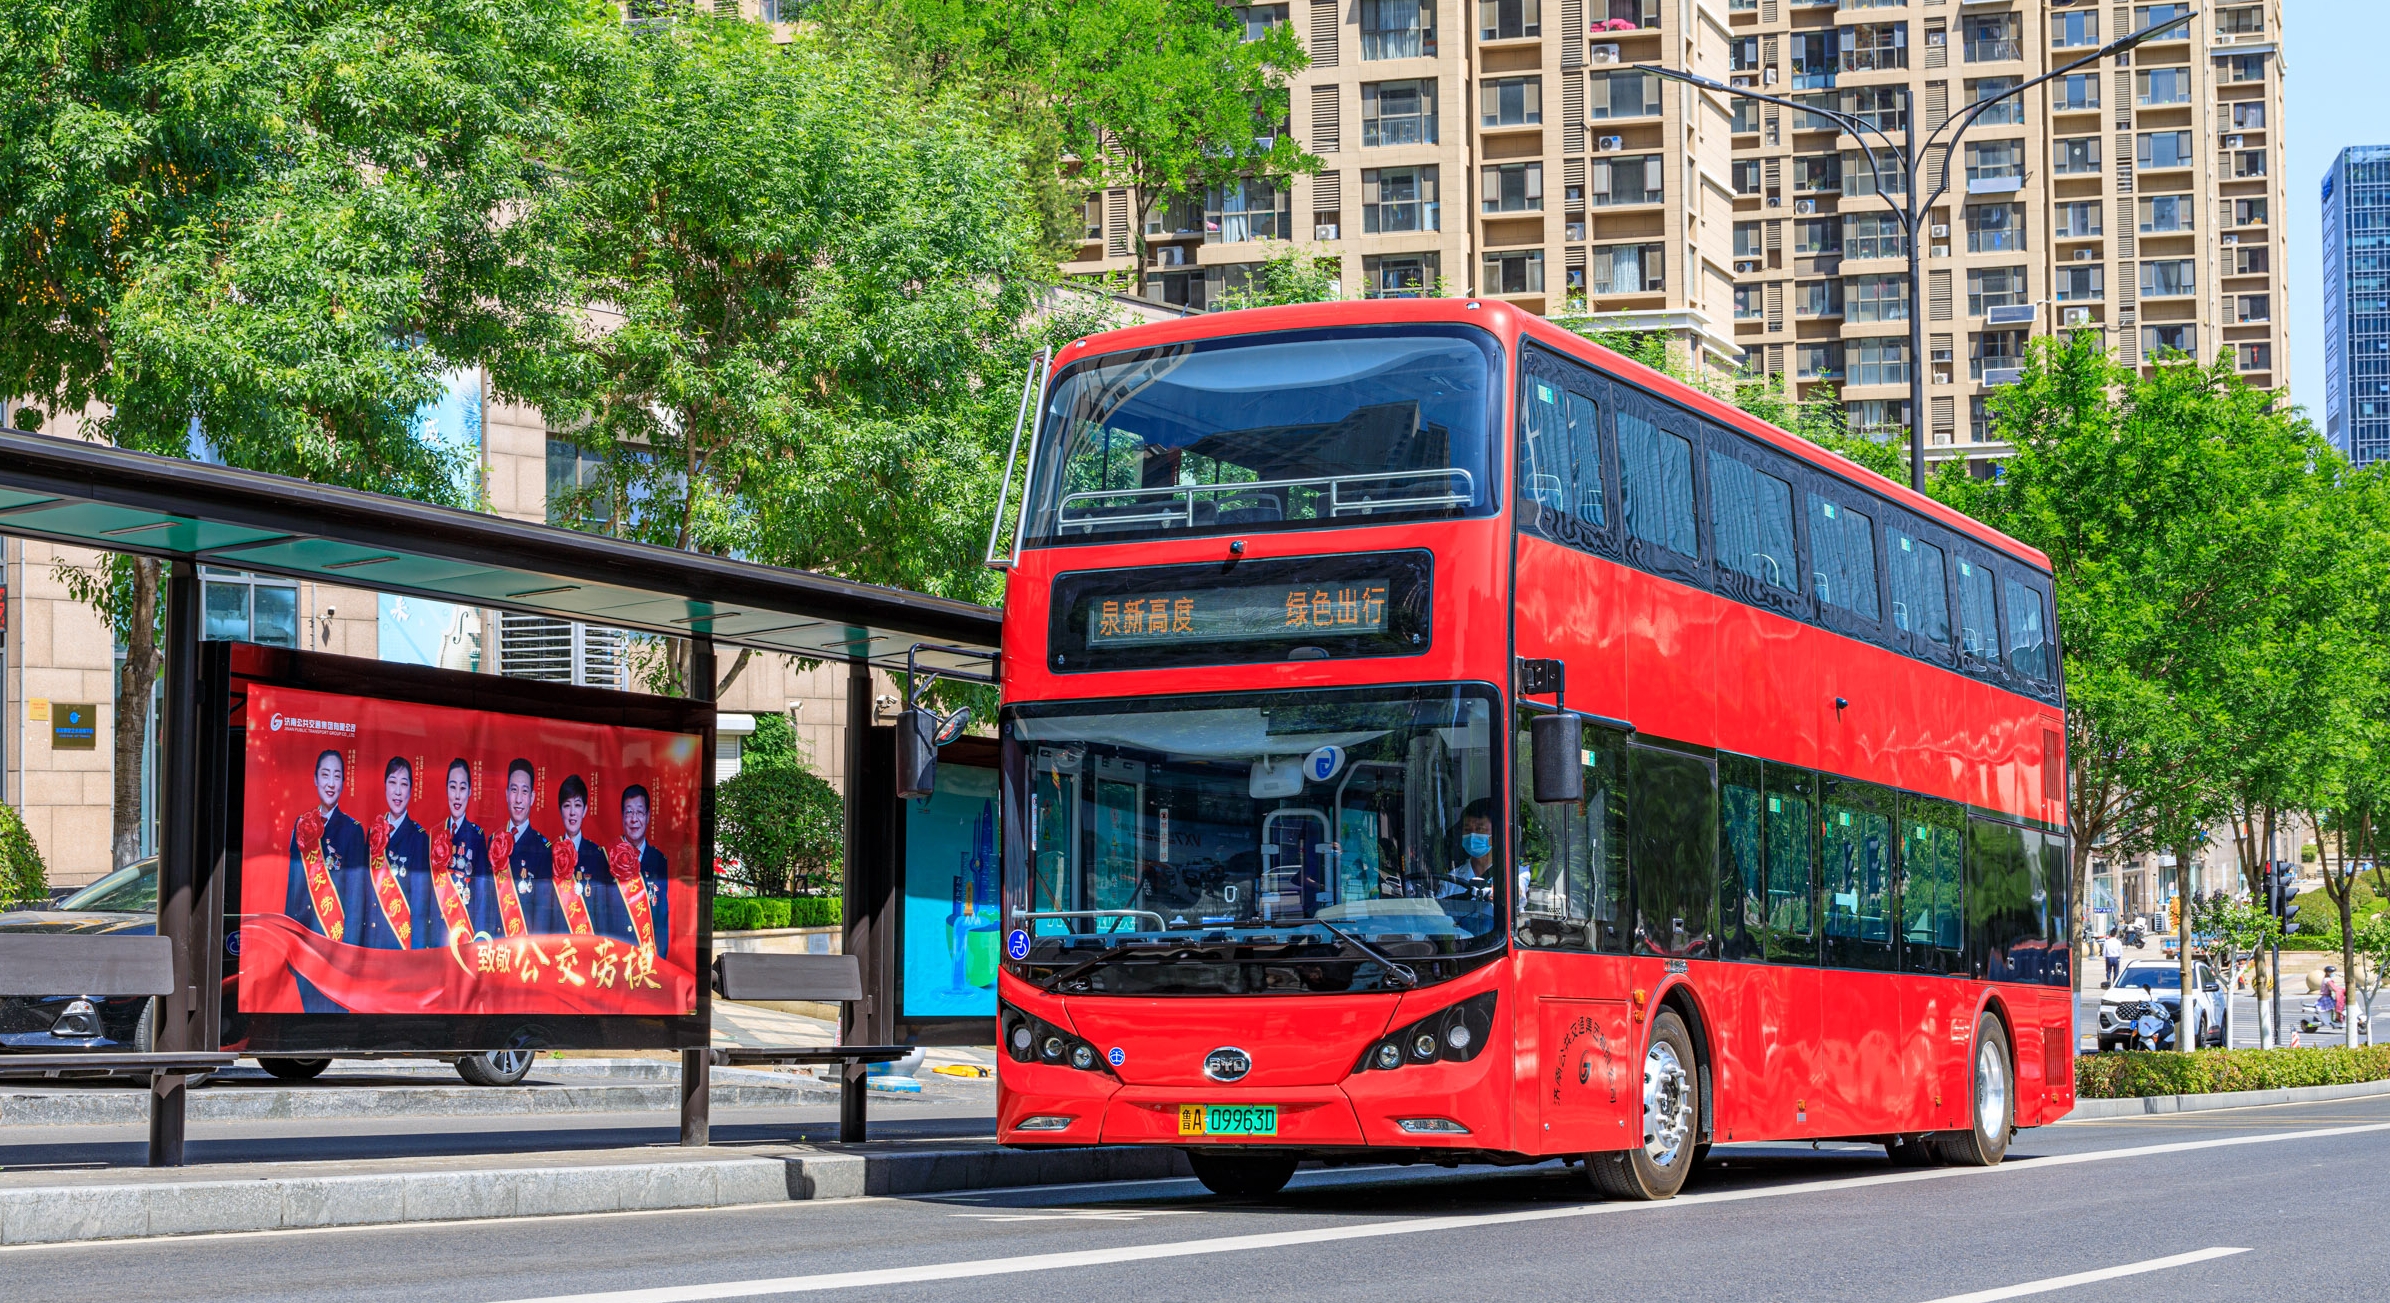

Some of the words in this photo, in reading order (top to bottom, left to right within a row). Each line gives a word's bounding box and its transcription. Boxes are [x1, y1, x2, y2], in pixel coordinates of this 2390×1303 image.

[1100, 597, 1194, 635] 泉新高度
[1286, 587, 1385, 627] 绿色出行
[284, 717, 356, 732] 济南公共交通集团有限公司
[1209, 1057, 1246, 1072] BYD
